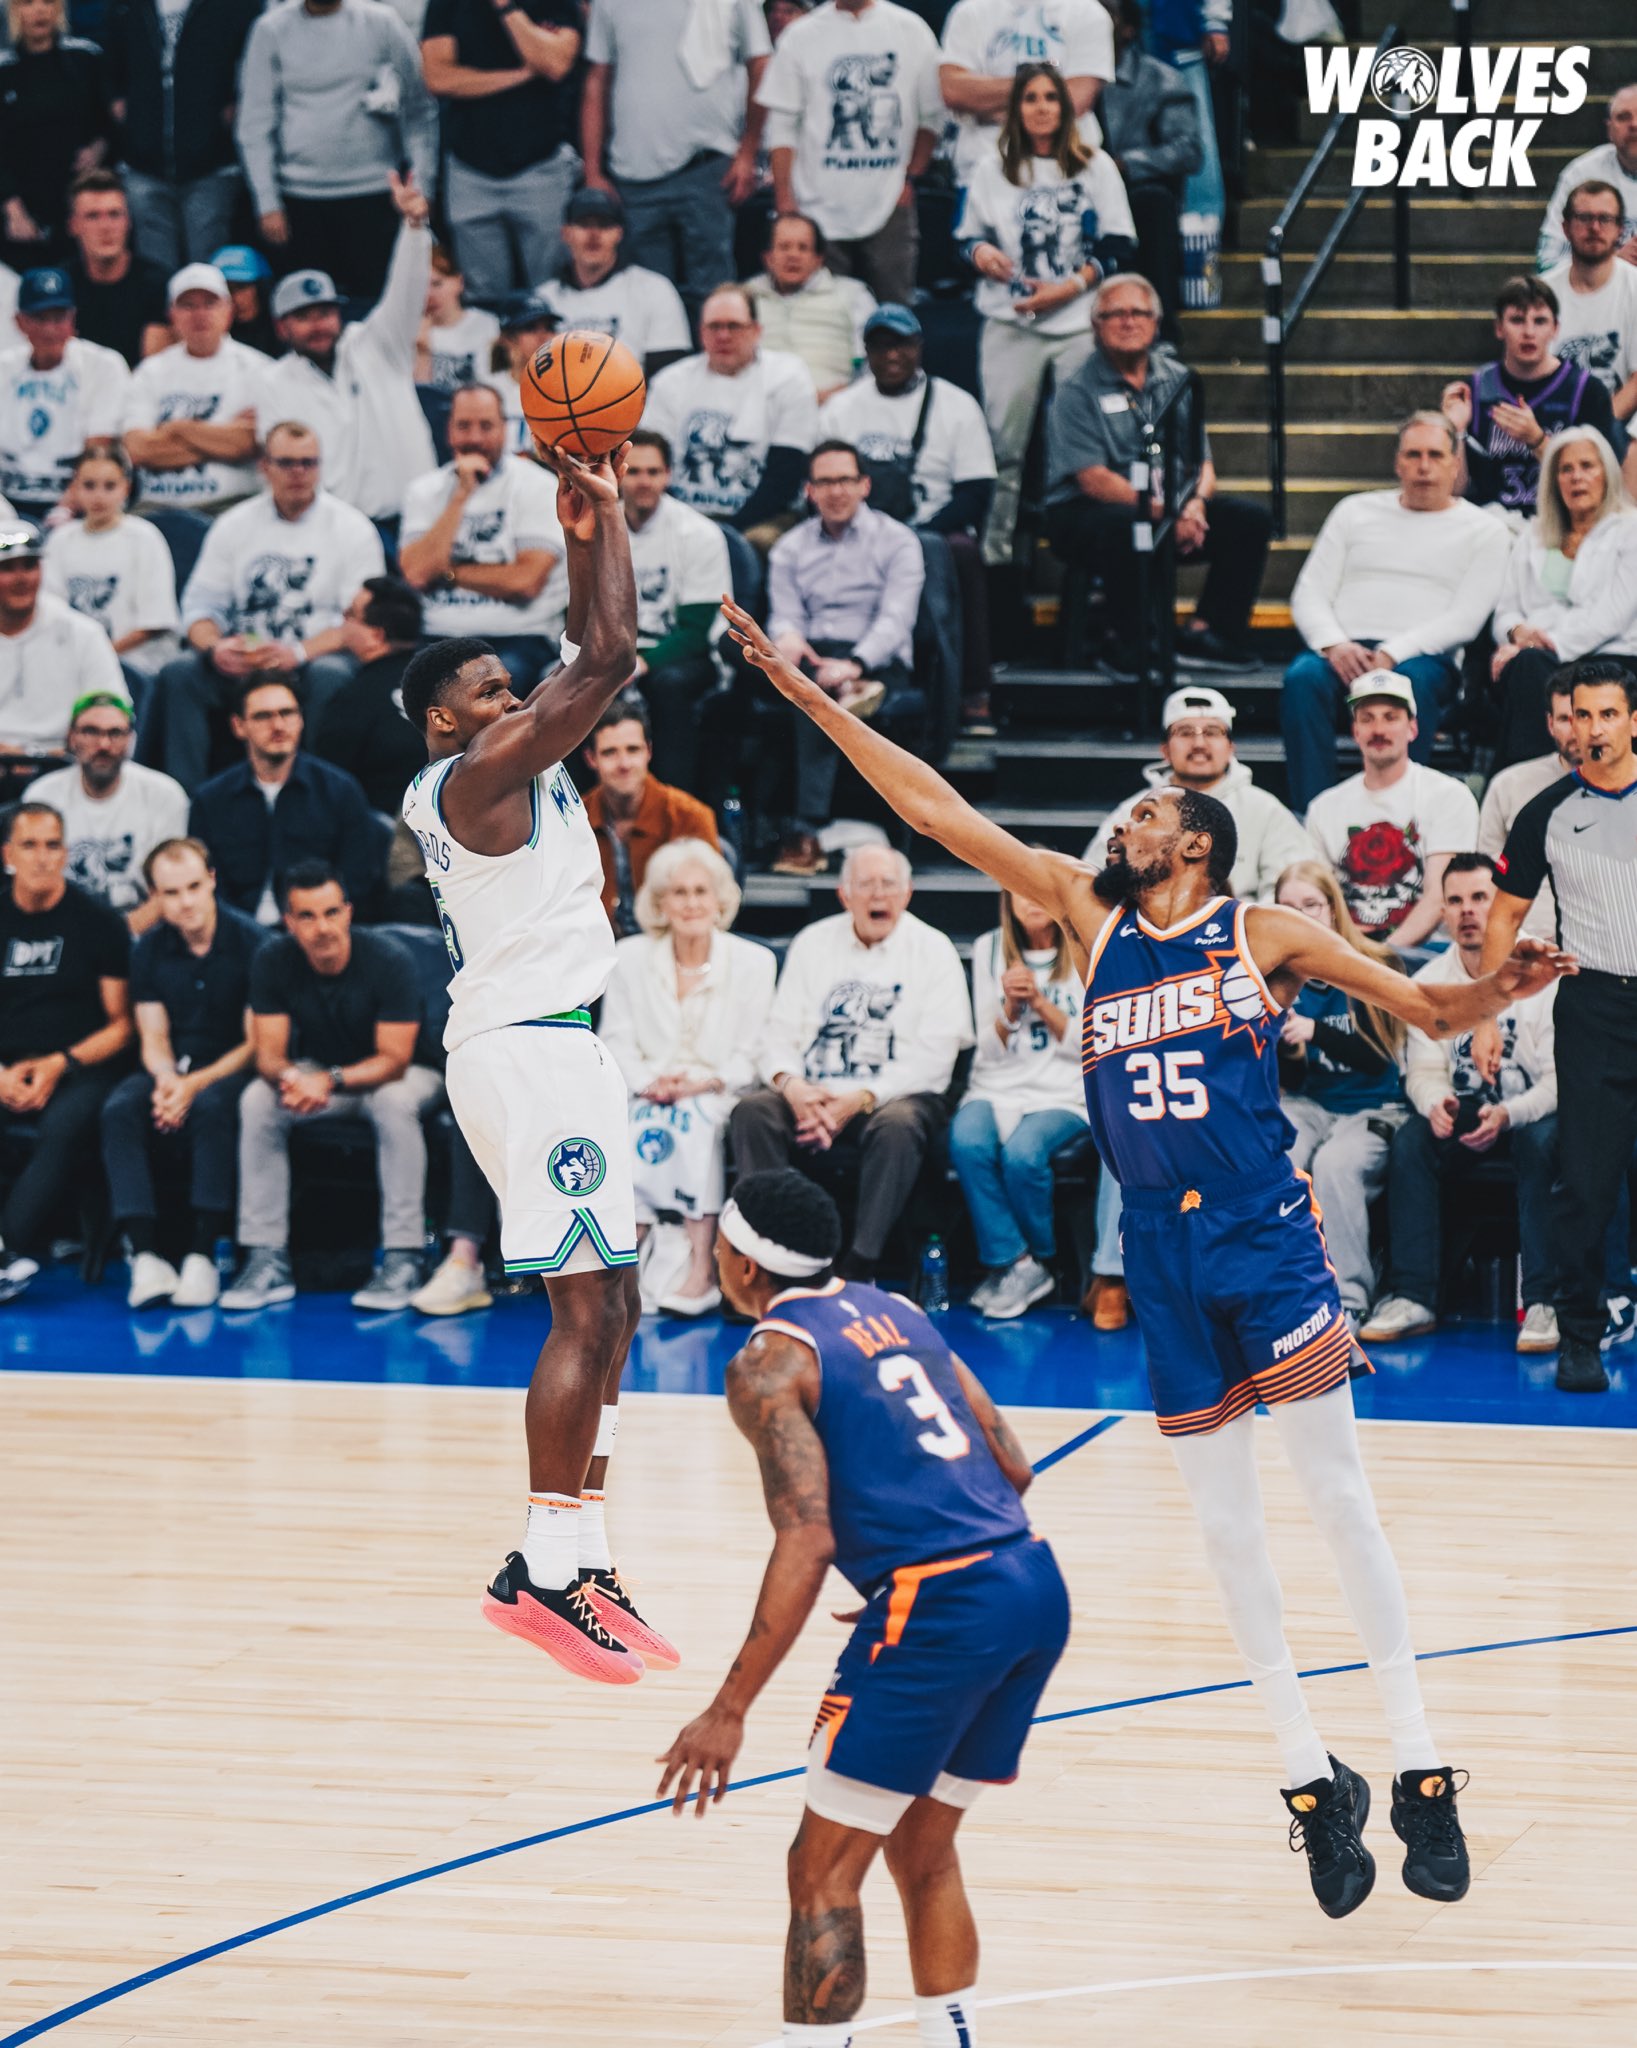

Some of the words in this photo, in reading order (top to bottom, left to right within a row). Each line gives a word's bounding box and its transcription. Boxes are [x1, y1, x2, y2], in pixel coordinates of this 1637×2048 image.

[1194, 934, 1229, 946] PayPal
[1030, 1020, 1050, 1051] 5
[1093, 974, 1216, 1056] SUNS
[1125, 1050, 1210, 1121] 35
[841, 1313, 910, 1359] BEAL
[1272, 1302, 1332, 1359] PHOENIX
[877, 1354, 970, 1461] 3
